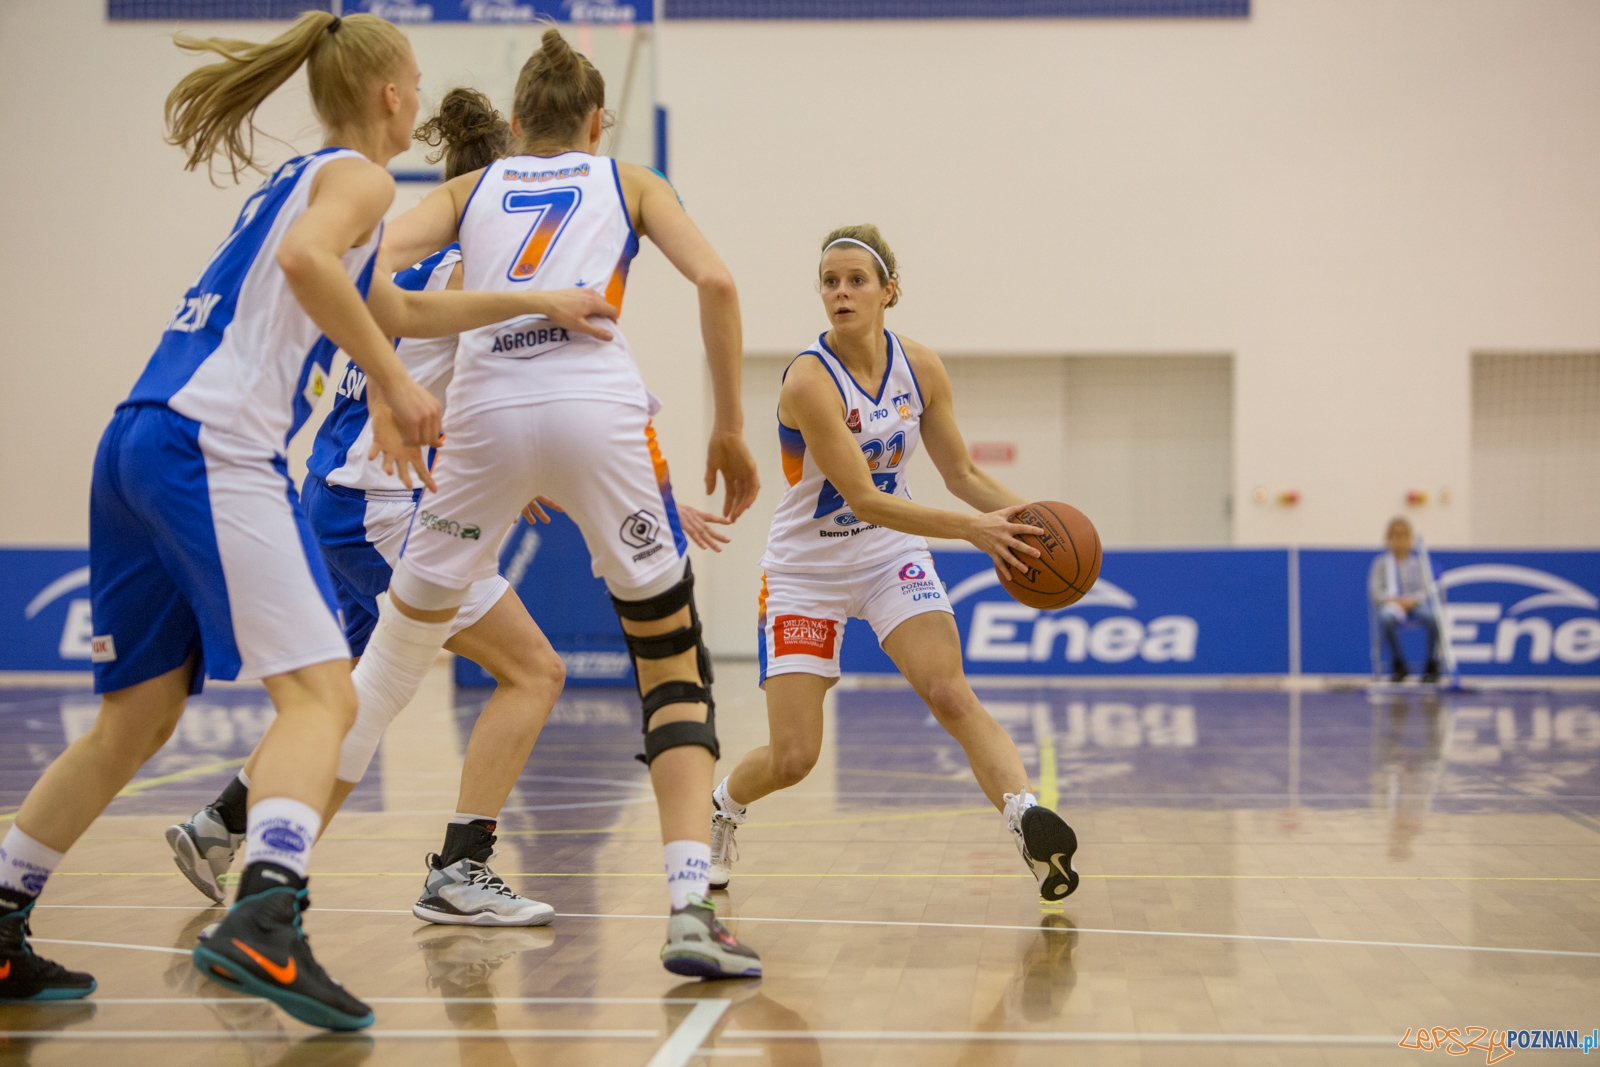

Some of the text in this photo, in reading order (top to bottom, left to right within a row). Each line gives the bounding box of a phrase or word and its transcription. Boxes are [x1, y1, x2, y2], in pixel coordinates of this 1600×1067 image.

[503, 186, 582, 282] 7
[491, 327, 570, 353] AGROBEX
[861, 430, 906, 471] 21
[820, 529, 850, 538] Bemo
[783, 627, 828, 641] SZPIKU
[965, 601, 1199, 663] Enea
